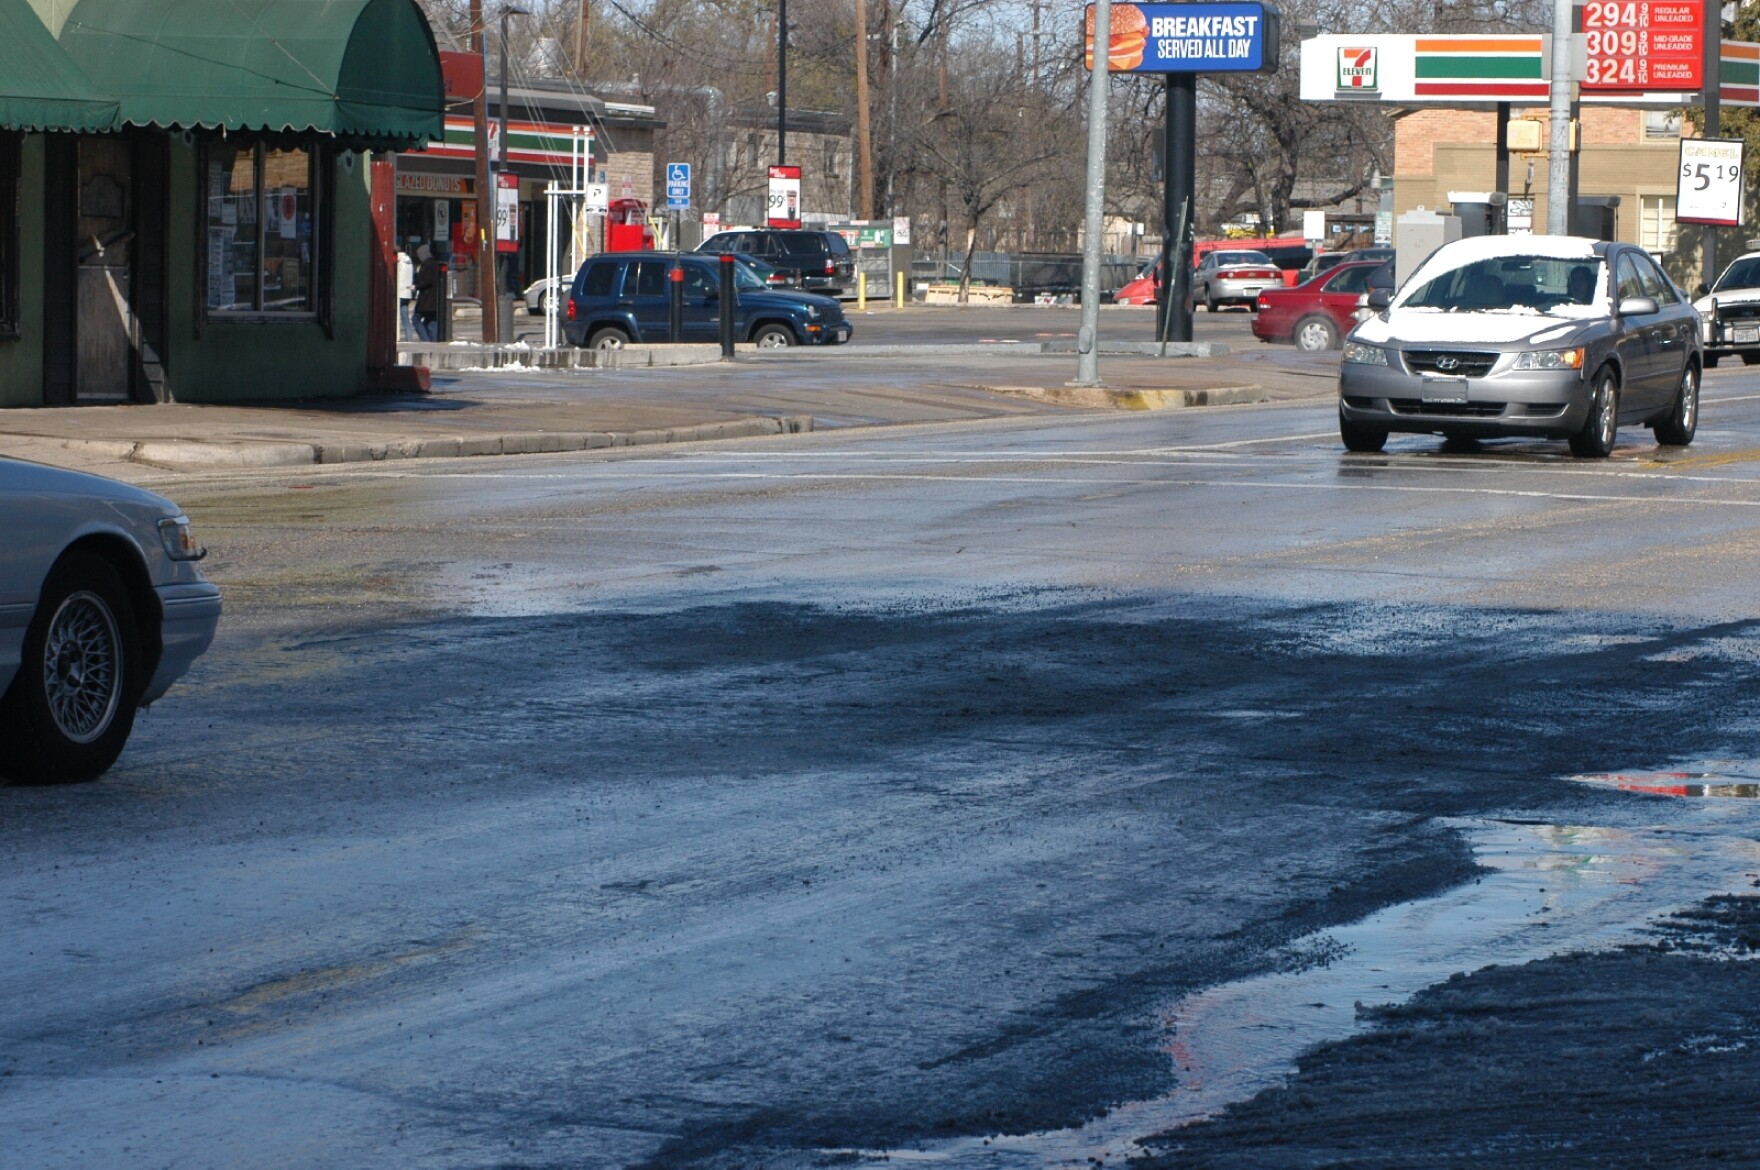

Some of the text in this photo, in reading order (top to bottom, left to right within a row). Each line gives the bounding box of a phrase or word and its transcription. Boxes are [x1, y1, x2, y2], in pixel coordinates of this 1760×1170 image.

[1152, 16, 1258, 37] BREAKFAST
[1587, 2, 1637, 27] 294
[1158, 39, 1251, 58] SERVED ALL DAY
[1587, 30, 1636, 55] 309
[1344, 48, 1371, 87] 7
[1586, 58, 1635, 83] 324
[396, 175, 461, 192] GLAZED DONUTS
